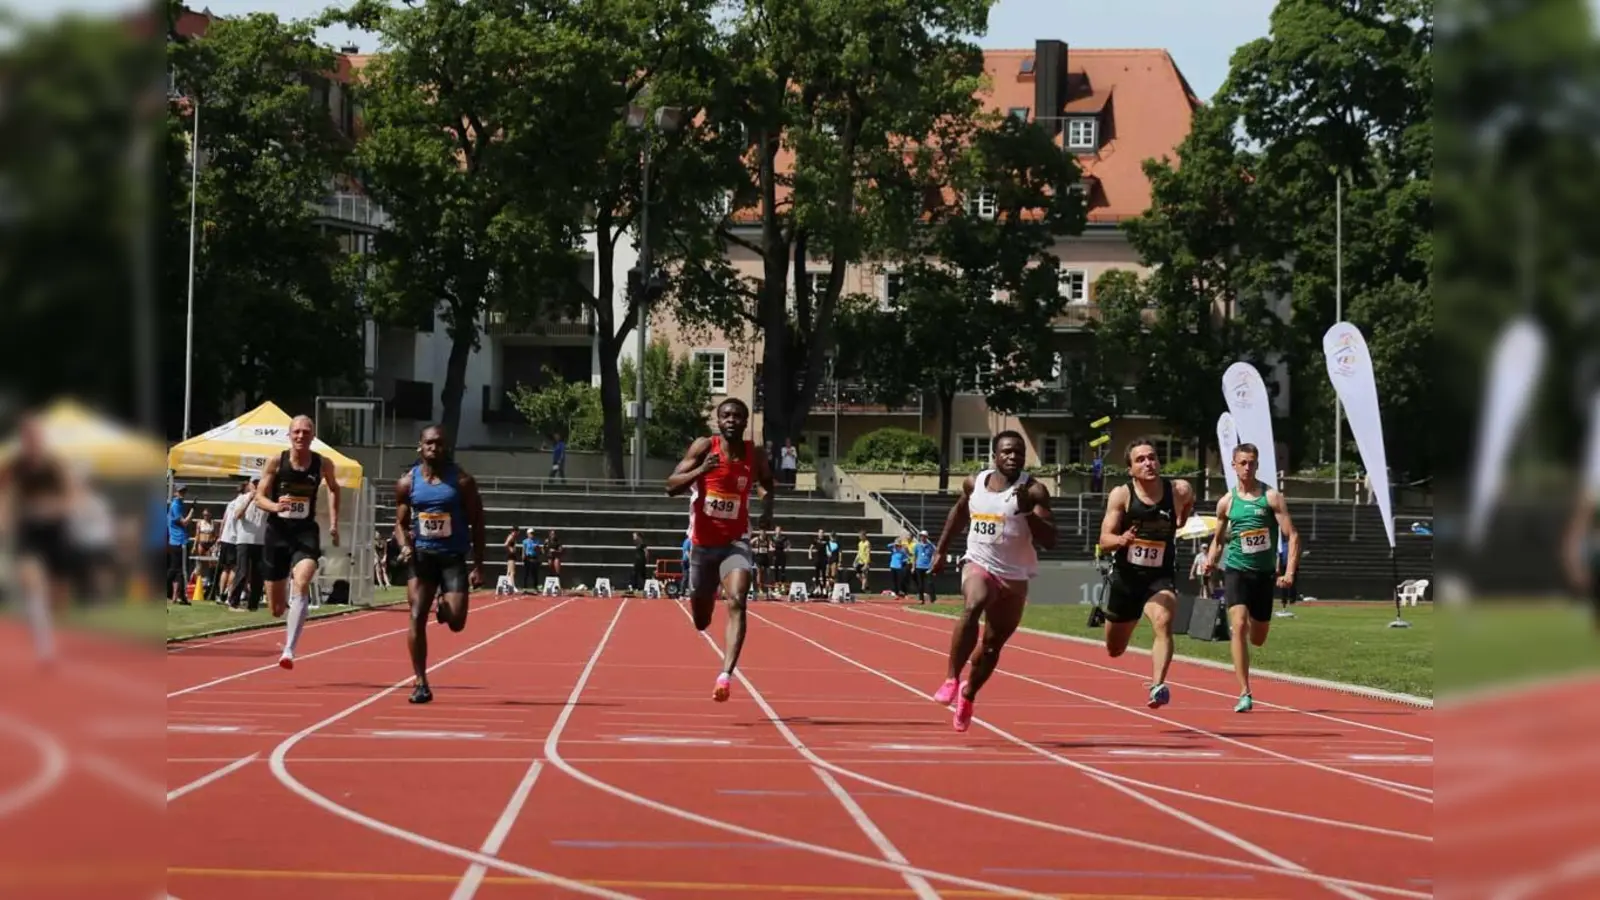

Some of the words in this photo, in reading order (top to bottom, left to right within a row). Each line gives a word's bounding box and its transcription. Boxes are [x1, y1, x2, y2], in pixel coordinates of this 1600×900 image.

[710, 499, 734, 512] 439
[424, 519, 445, 530] 437
[973, 521, 996, 535] 438
[1246, 534, 1266, 546] 522
[1134, 545, 1158, 559] 313
